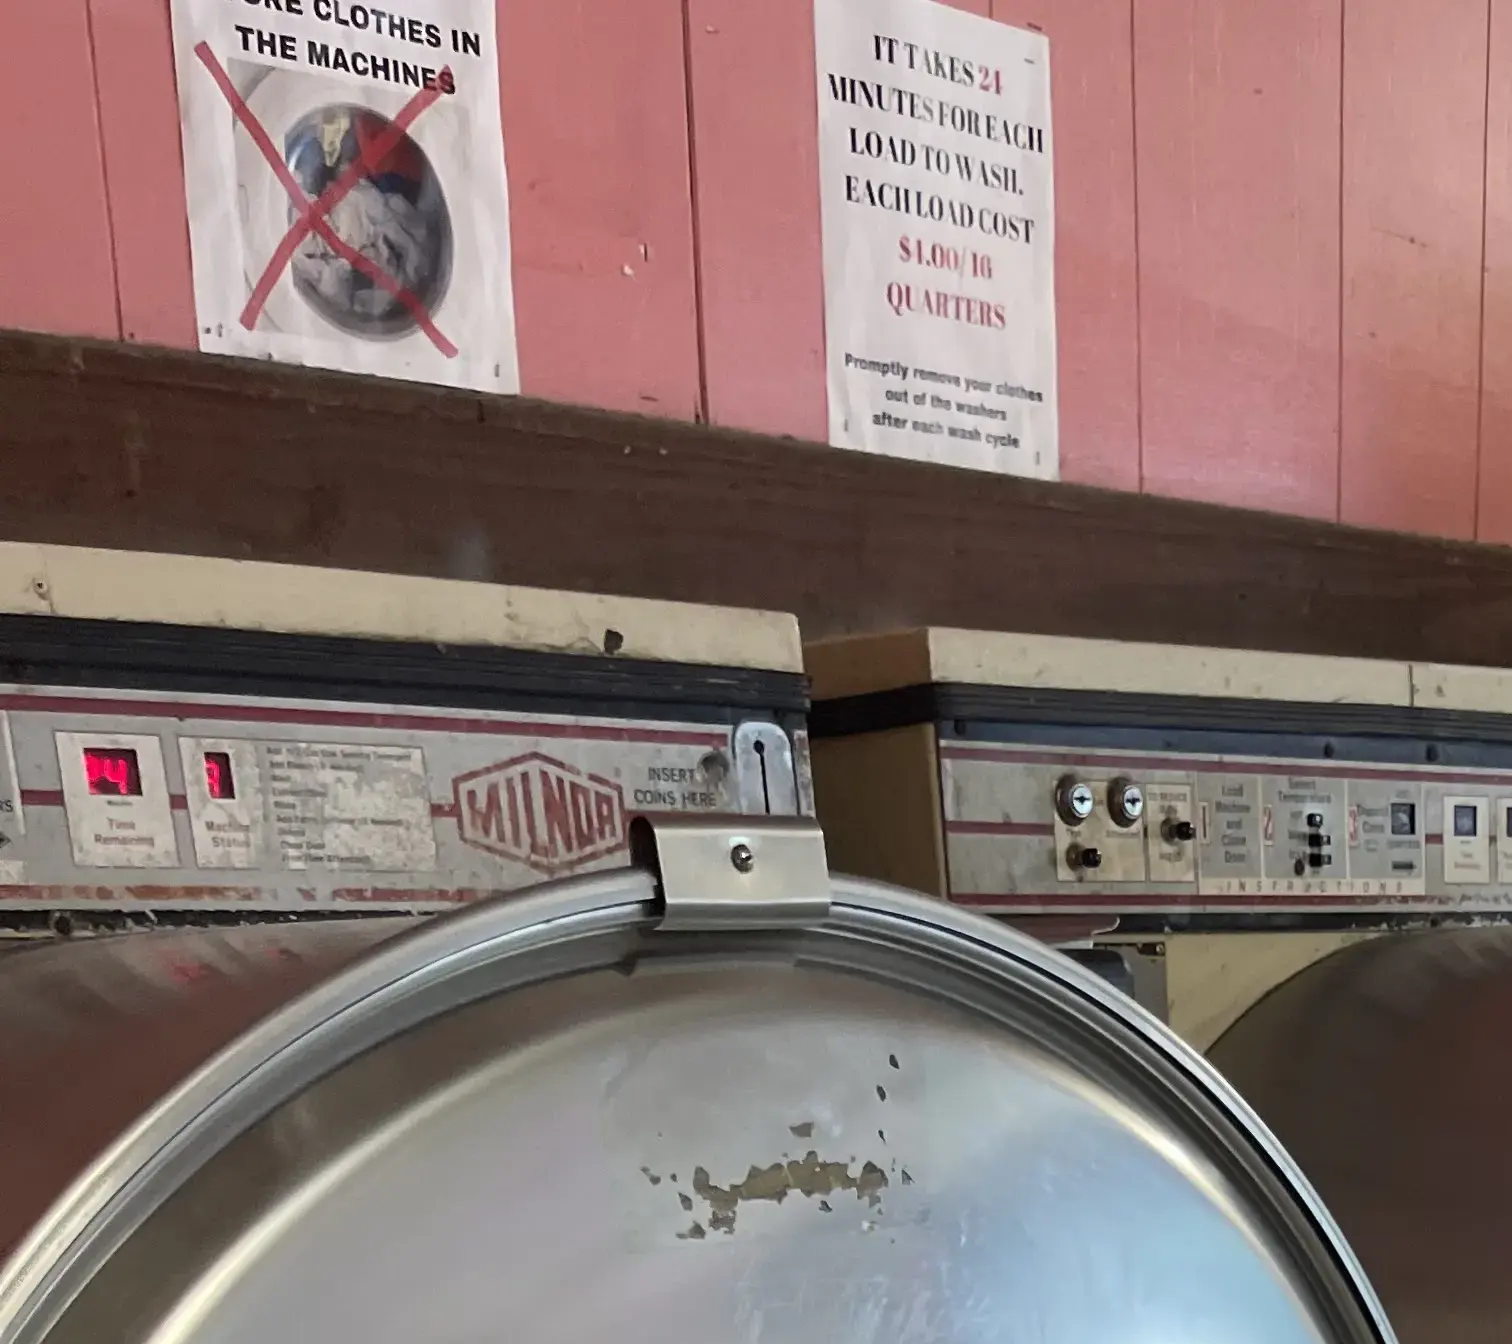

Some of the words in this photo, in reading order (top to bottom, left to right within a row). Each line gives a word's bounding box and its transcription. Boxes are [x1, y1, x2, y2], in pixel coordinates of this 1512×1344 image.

[313, 0, 441, 48] CLOTHES
[451, 29, 480, 57] IN
[235, 25, 298, 61] THE
[307, 40, 456, 95] MACHINES
[873, 35, 898, 64] IT
[904, 42, 975, 87] TAKES
[827, 73, 934, 122] MINUTES
[938, 101, 981, 137] FOR
[986, 114, 1043, 153] EACH
[850, 126, 916, 166] LOAD
[921, 144, 950, 176] TO
[955, 152, 1024, 195] WASH.
[845, 174, 910, 214] EACH
[916, 191, 974, 229] LOAD
[979, 208, 1034, 244] COST
[887, 281, 1006, 329] QUARTERS
[845, 352, 909, 381] Promptly
[913, 368, 960, 387] remove
[964, 377, 992, 393] your
[996, 382, 1043, 403] clothes
[872, 411, 908, 429] after
[912, 420, 944, 435] each
[947, 425, 981, 442] wash
[985, 432, 1019, 449] cycle
[885, 388, 908, 404] out
[913, 392, 927, 406] of
[930, 395, 951, 411] the
[956, 401, 1007, 421] washers
[633, 788, 676, 806] COINS
[681, 791, 717, 807] HERE
[648, 766, 695, 783] INSERT
[106, 817, 136, 831] Time
[466, 766, 618, 858] MILNOR
[93, 833, 155, 848] Remaining
